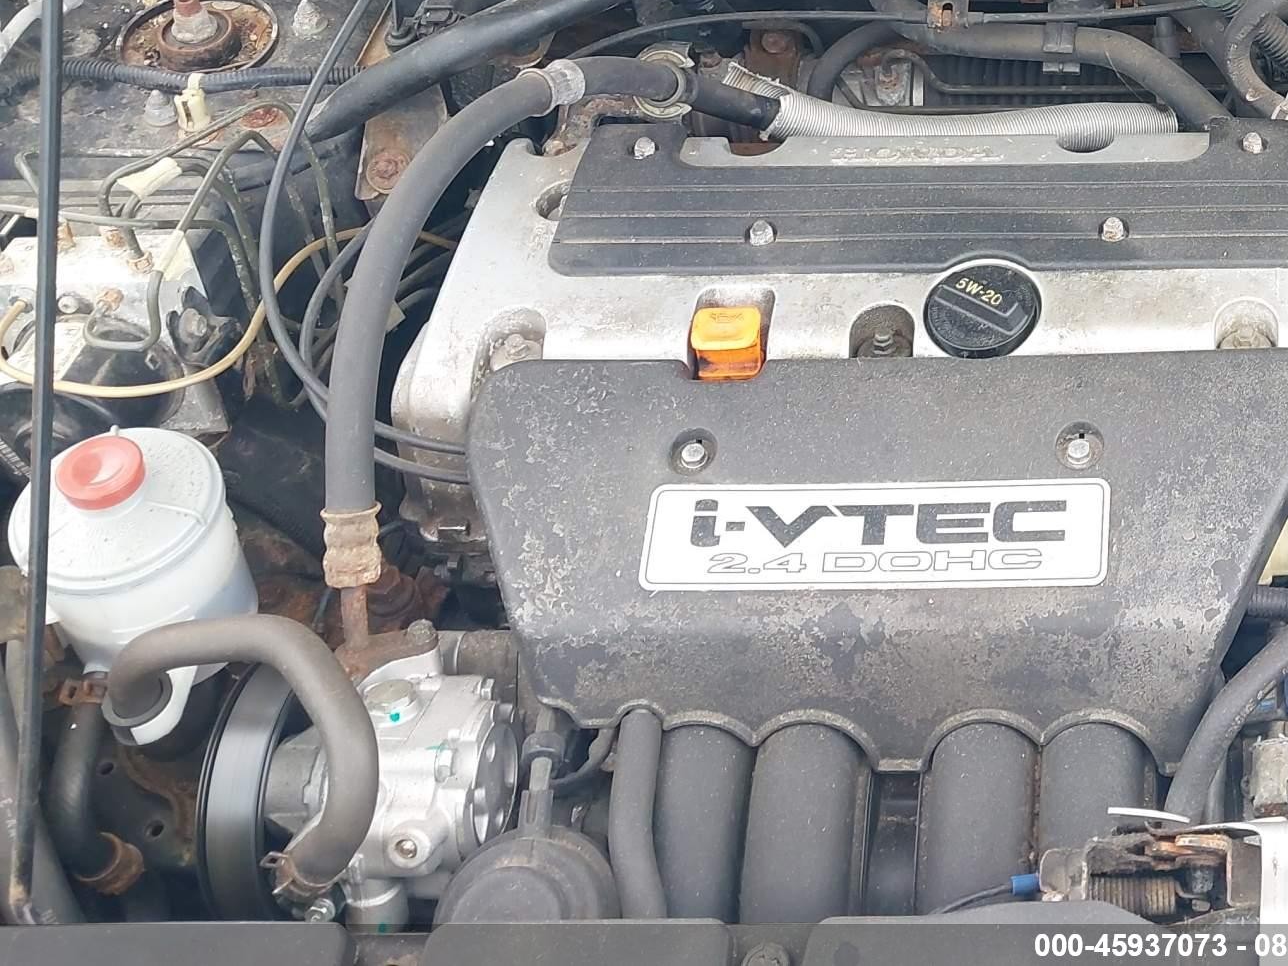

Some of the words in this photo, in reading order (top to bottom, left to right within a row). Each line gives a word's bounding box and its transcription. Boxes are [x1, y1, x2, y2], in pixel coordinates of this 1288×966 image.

[955, 277, 1003, 306] 5W-20
[690, 499, 1067, 548] i-VTEC
[706, 552, 807, 574] 2.4
[822, 548, 1042, 573] DOHC
